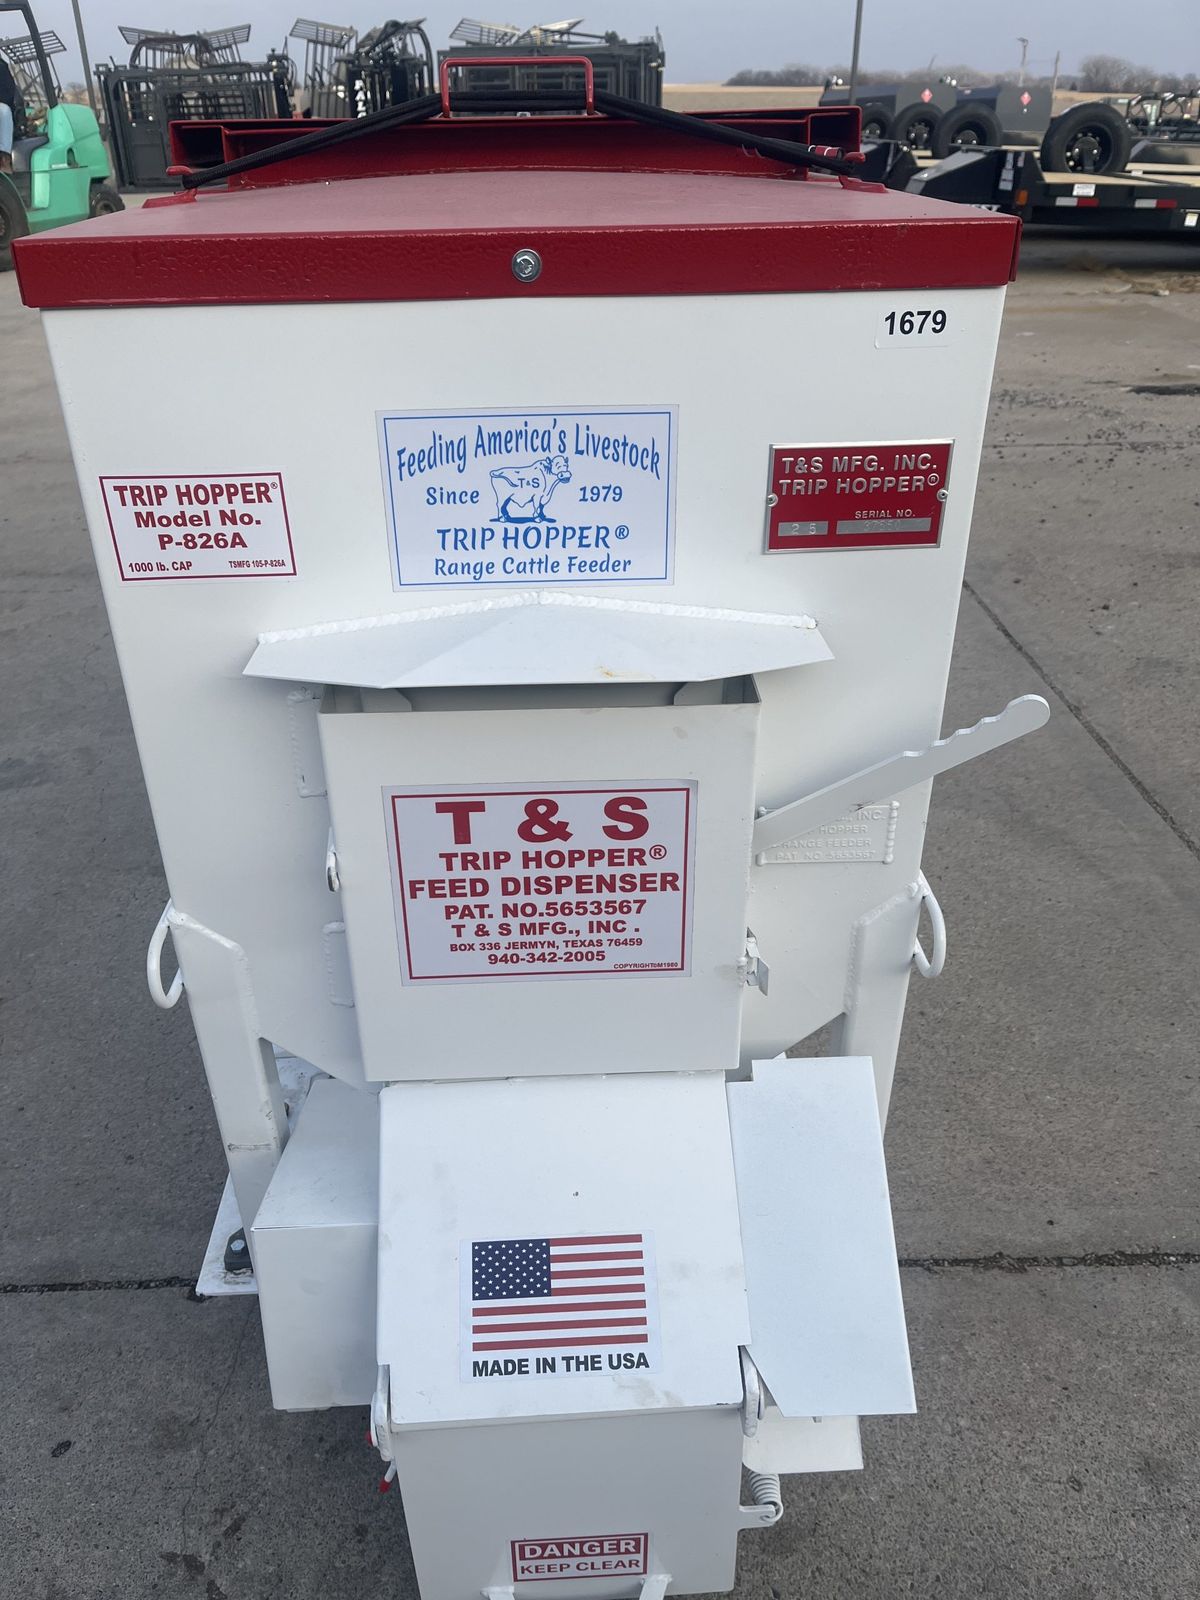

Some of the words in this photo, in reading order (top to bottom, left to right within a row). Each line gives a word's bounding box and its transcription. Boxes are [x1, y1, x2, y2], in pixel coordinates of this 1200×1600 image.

[885, 309, 947, 335] 1679
[397, 430, 467, 482] Feeding
[474, 418, 567, 458] America's
[574, 423, 661, 480] Livestock
[782, 456, 823, 474] T&S
[832, 455, 885, 473] MFG.
[894, 453, 937, 471] INC.
[517, 477, 540, 488] T&S
[779, 478, 828, 495] TRIP
[113, 484, 168, 507] TRIP
[426, 486, 480, 505] Since
[579, 485, 623, 502] 1979
[134, 510, 211, 528] Model
[219, 509, 261, 526] No.
[854, 509, 892, 520] SERIAL
[896, 508, 916, 518] NO.
[158, 532, 248, 550] P-826A
[437, 527, 495, 551] TRIP
[128, 562, 154, 573] 1000
[156, 561, 170, 572] lb.
[172, 560, 193, 571] CAP
[228, 560, 251, 569] TSMFG
[251, 559, 286, 568] 105-P-826A
[435, 557, 495, 580] Range
[502, 554, 560, 575] Cattle
[568, 553, 631, 573] Feeder
[435, 800, 486, 845] T
[517, 798, 573, 843] &
[601, 796, 650, 841] S
[819, 824, 868, 835] HOPPER
[825, 837, 872, 848] FEEDER
[439, 851, 511, 871] TRIP
[408, 878, 490, 899] FEED
[501, 872, 680, 896] DISPENSER
[444, 904, 494, 920] PAT.
[502, 899, 647, 918] NO.5653567
[451, 924, 466, 937] T
[474, 923, 490, 937] &
[498, 922, 512, 937] S
[519, 921, 580, 937] MFG.,
[450, 943, 475, 952] BOX
[479, 942, 501, 951] 336
[504, 940, 559, 951] JERMYN,
[563, 938, 603, 948] TEXAS
[607, 937, 643, 947] 76459
[488, 950, 606, 964] 940-342-2005
[472, 1357, 530, 1377] MADE
[536, 1356, 556, 1374] IN
[561, 1354, 603, 1372] THE
[608, 1352, 650, 1370] USA
[524, 1539, 636, 1559] DANGER
[520, 1563, 571, 1574] KEEP
[576, 1559, 640, 1571] CLEAR
